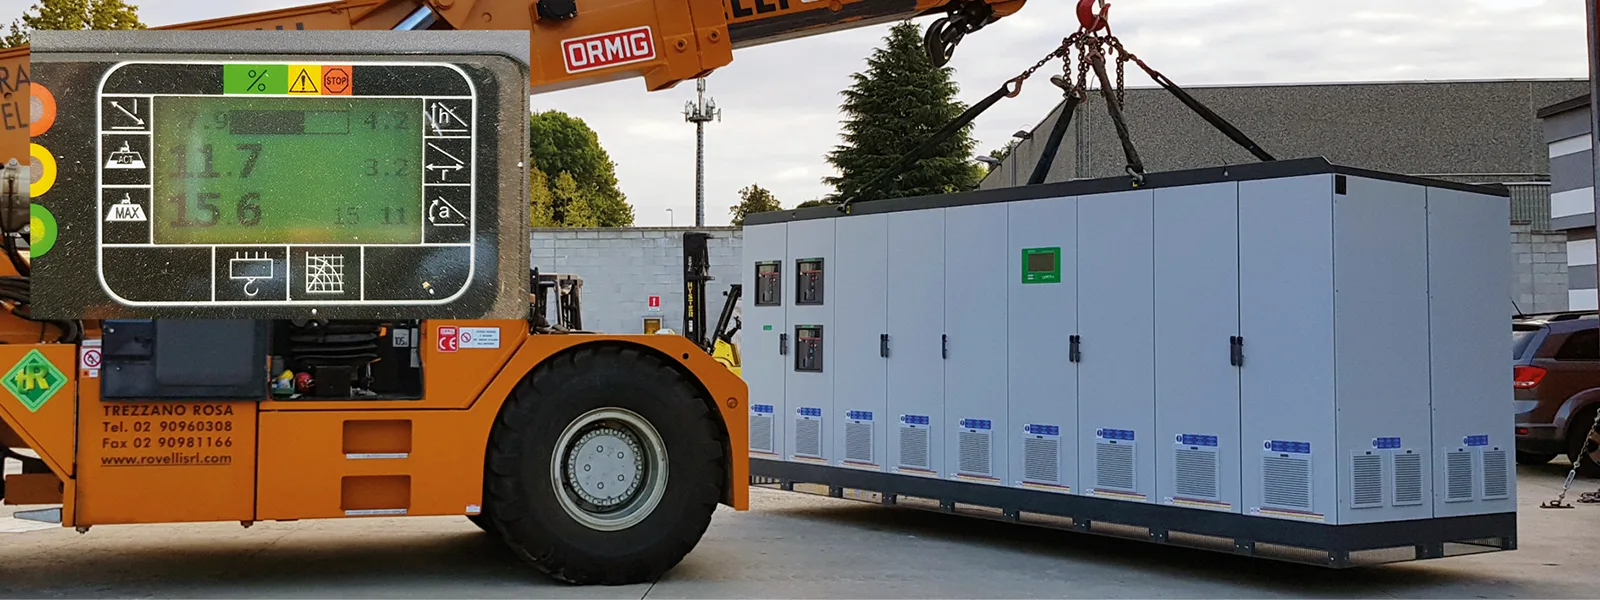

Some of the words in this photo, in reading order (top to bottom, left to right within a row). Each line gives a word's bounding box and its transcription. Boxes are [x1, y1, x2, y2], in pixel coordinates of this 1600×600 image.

[568, 32, 649, 67] ORMIG
[247, 70, 267, 91] %
[326, 76, 346, 85] STOP
[185, 111, 228, 130] 7.9
[363, 111, 409, 131] 4.2
[439, 108, 449, 123] h
[117, 155, 133, 165] ACT
[169, 144, 262, 178] 11.7
[363, 158, 409, 177] 3.2
[441, 169, 449, 181] r
[115, 207, 140, 219] MAX
[169, 192, 262, 227] 15.6
[335, 206, 360, 225] 15
[380, 206, 406, 225] 11
[439, 206, 450, 218] a
[439, 336, 456, 350] CE
[103, 405, 186, 416] TREZZANO
[193, 405, 234, 416] ROSA
[103, 421, 128, 432] Tel.
[133, 421, 151, 432] 02
[160, 421, 232, 432] 90960308
[102, 438, 128, 449] Fax
[133, 437, 151, 448] 02
[158, 437, 232, 448] 90981166
[101, 452, 232, 465] www.rovellisrl.com
